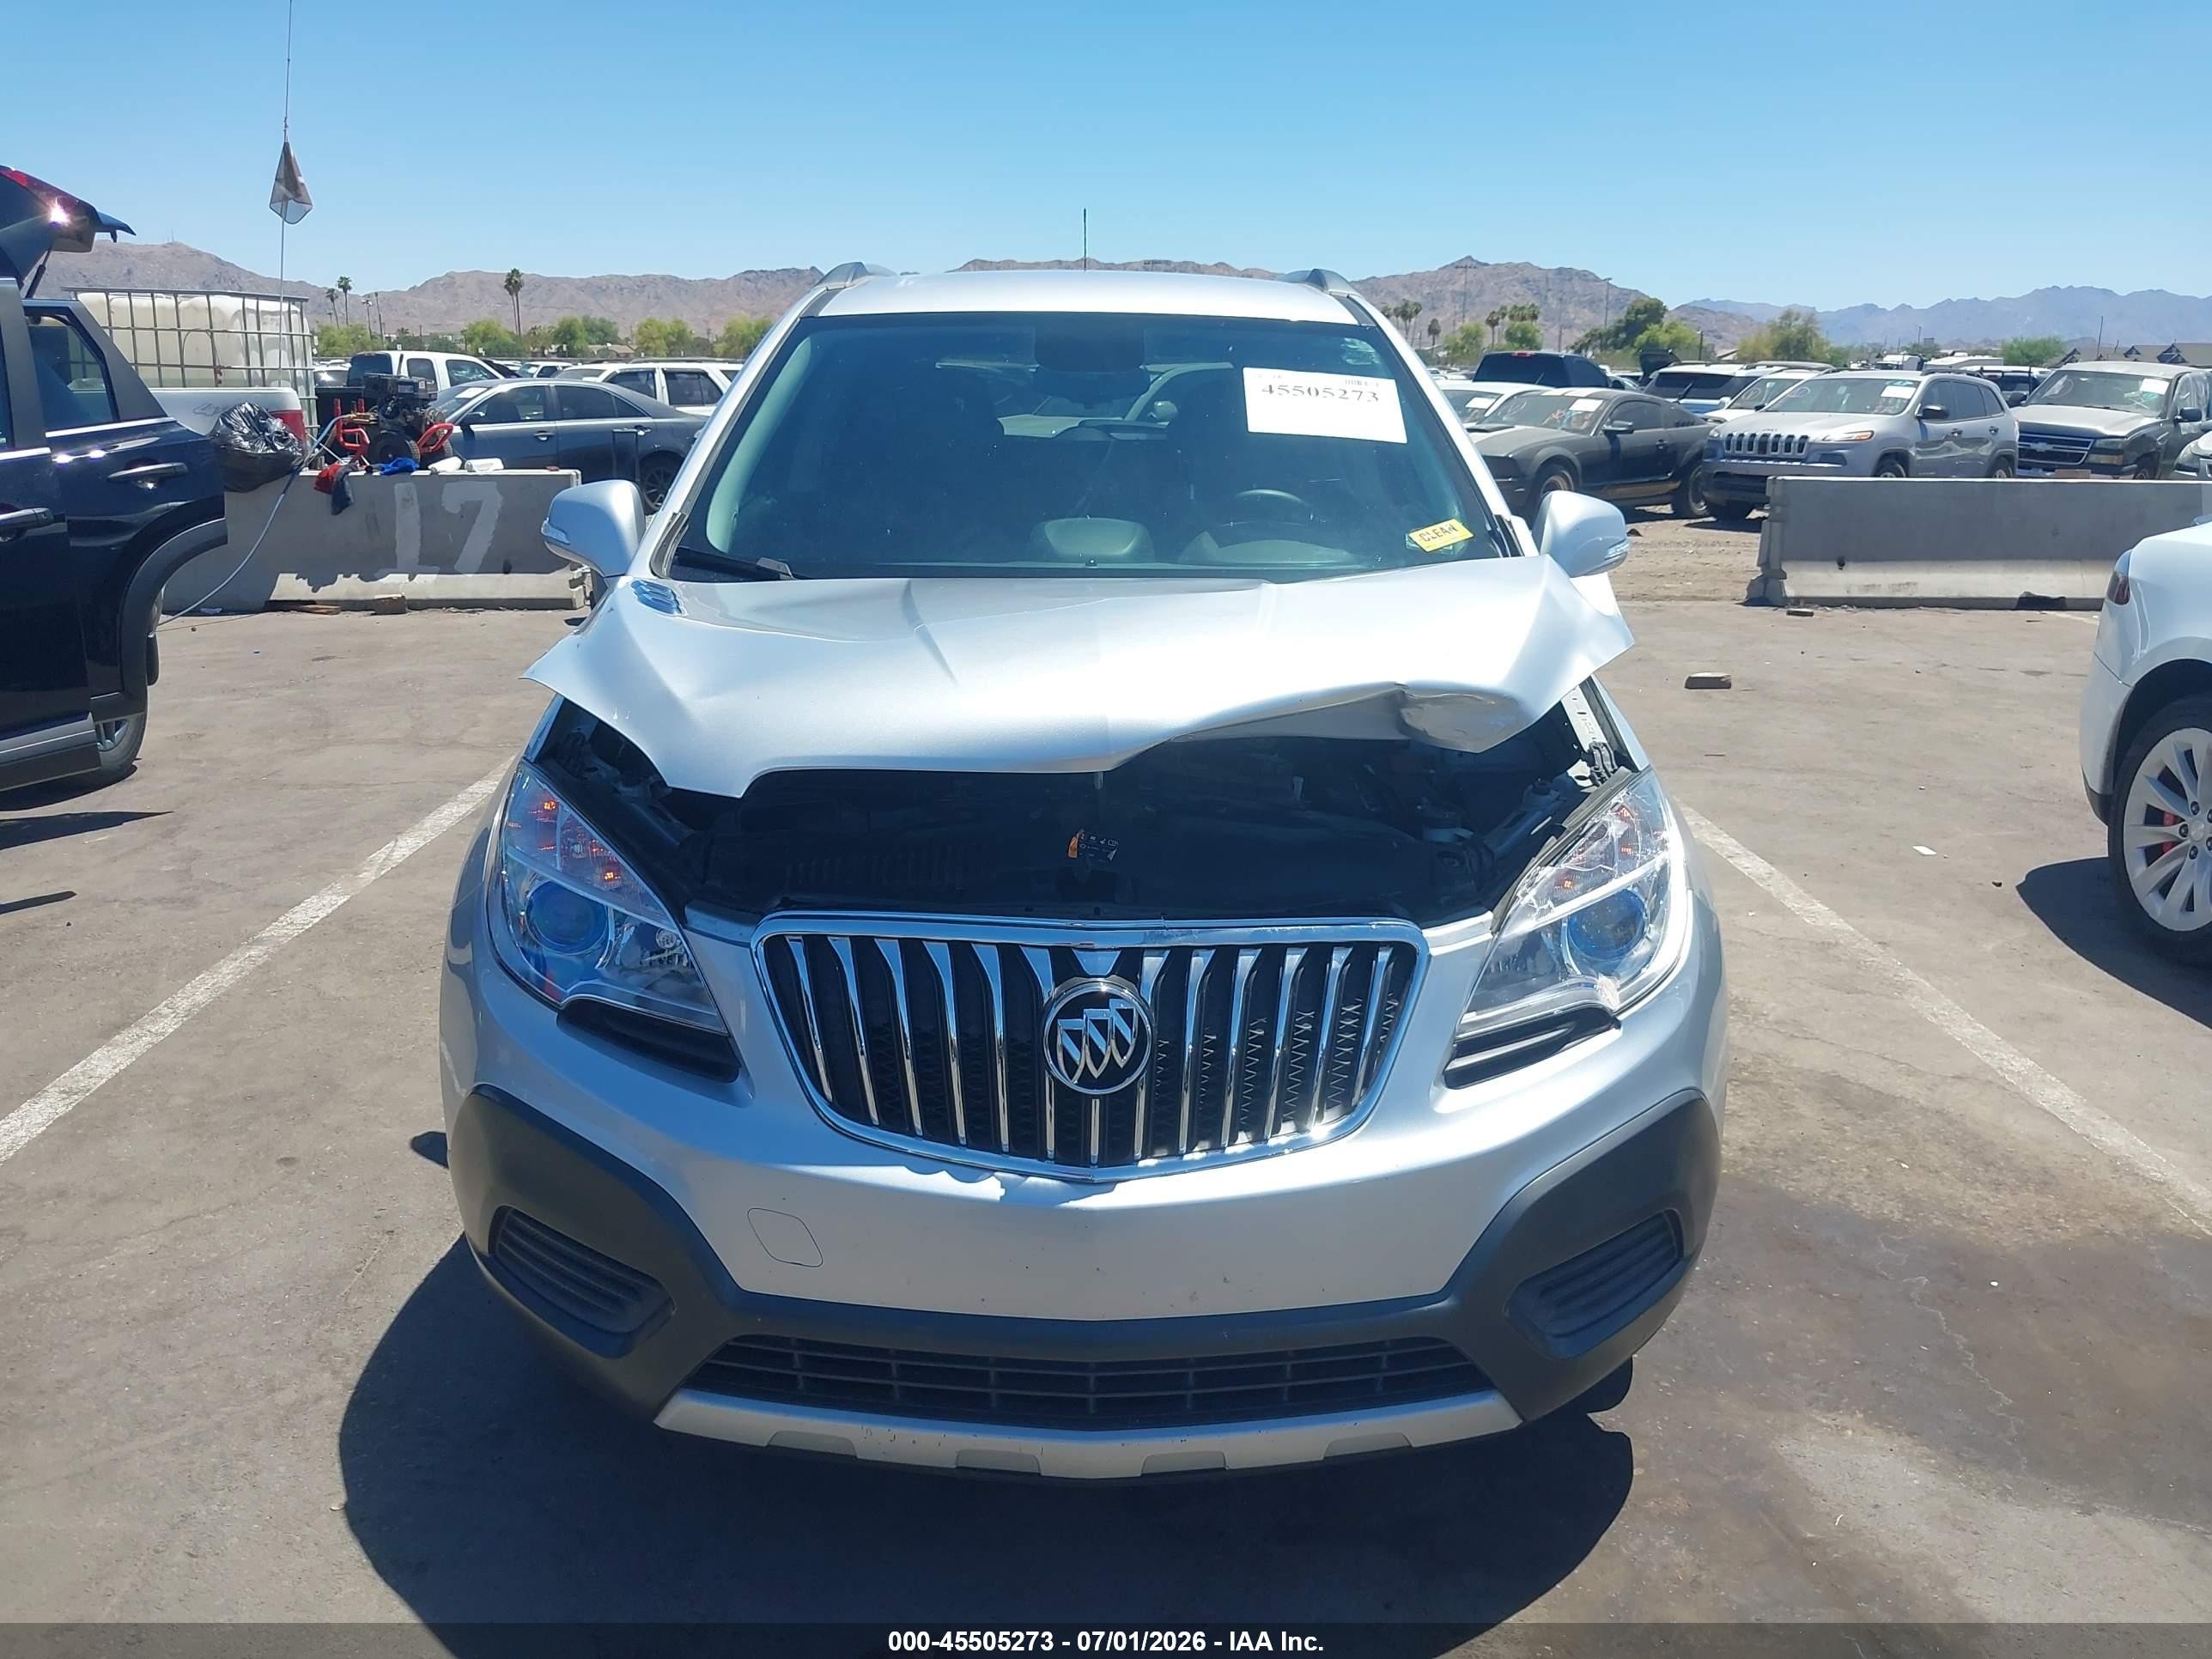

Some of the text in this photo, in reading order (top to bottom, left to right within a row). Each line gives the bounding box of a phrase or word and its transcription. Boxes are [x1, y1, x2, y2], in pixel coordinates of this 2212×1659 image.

[1261, 384, 1379, 403] 45505273
[374, 481, 504, 583] 17
[1419, 523, 1459, 542] CLEAN
